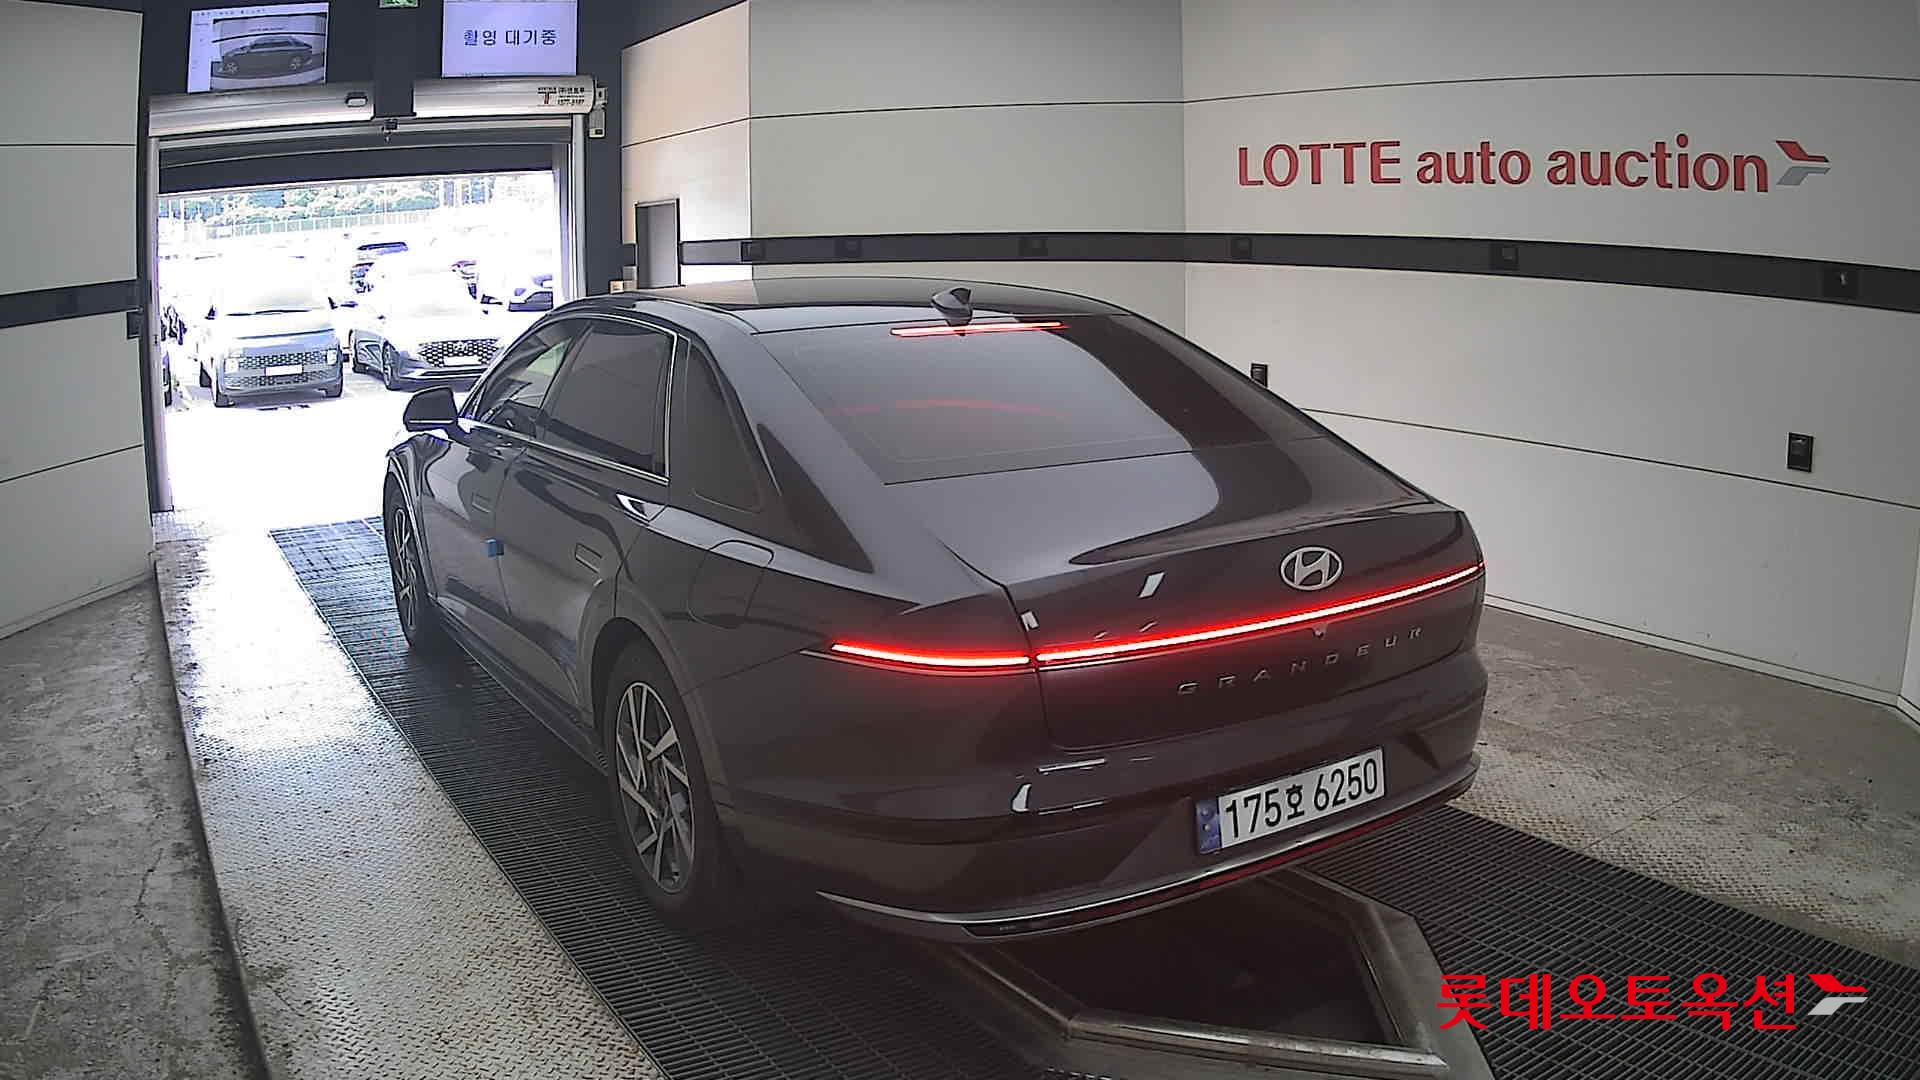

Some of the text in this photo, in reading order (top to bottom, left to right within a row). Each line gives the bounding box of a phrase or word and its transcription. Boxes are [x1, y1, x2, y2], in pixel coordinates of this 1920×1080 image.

[505, 29, 558, 46] 대기중
[1239, 134, 1769, 193] LOTTE auto auction
[1178, 627, 1422, 695] GRANDEUR
[1225, 759, 1378, 838] 175호 6250
